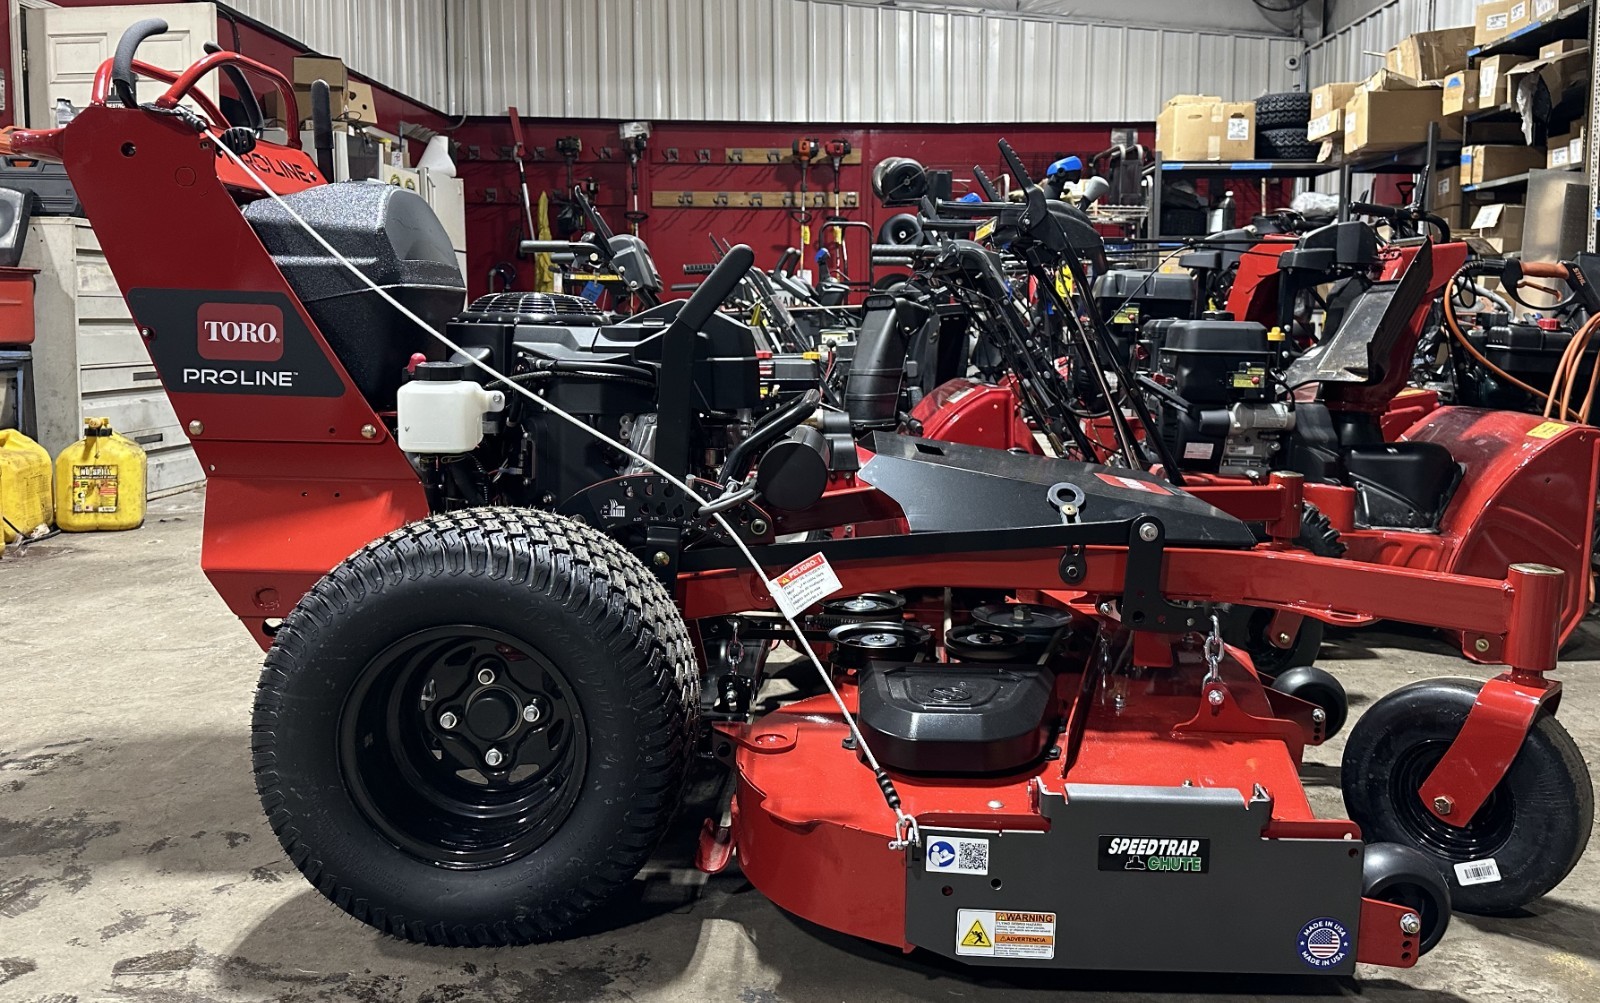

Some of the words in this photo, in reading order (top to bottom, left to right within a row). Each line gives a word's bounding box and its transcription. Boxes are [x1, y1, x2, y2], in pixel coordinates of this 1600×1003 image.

[1572, 267, 1586, 286] STIHL
[1108, 838, 1200, 856] SPEEDTRAP
[1147, 856, 1202, 871] CHUTE
[1006, 913, 1053, 922] WARNING
[1303, 921, 1323, 936] MADE
[1334, 924, 1346, 937] USA
[1302, 951, 1320, 966] MADE
[1330, 952, 1345, 964] USA
